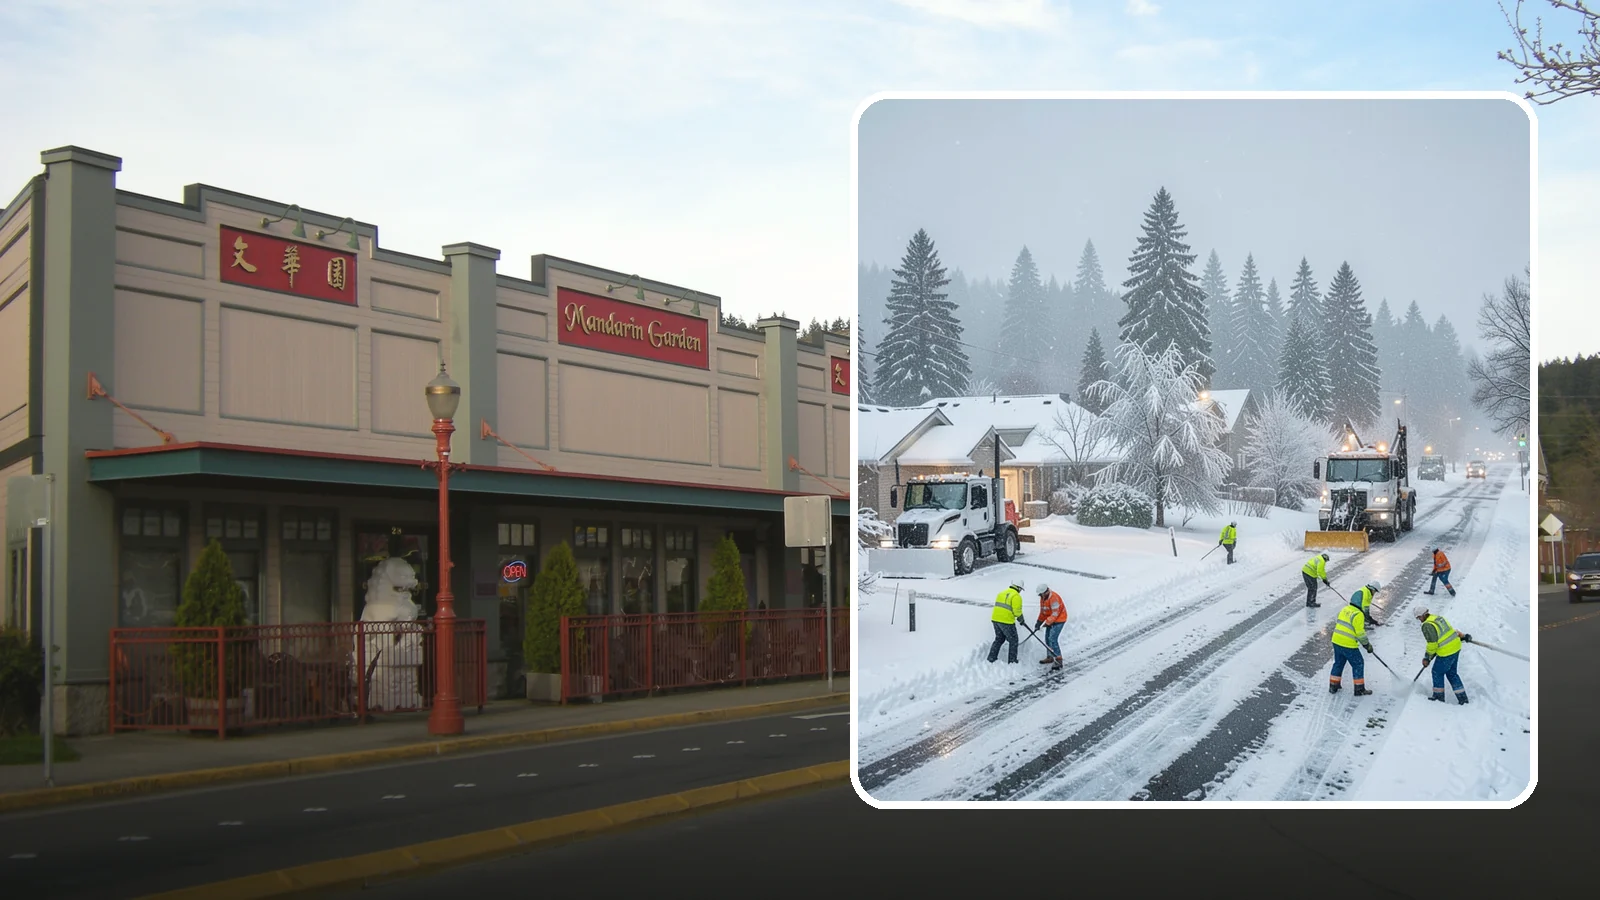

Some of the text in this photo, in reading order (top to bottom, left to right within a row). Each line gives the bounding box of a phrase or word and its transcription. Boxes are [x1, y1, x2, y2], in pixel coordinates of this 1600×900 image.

[231, 236, 346, 291] 文華園
[565, 302, 701, 352] Mandarin Garden
[503, 565, 526, 578] OPEN
